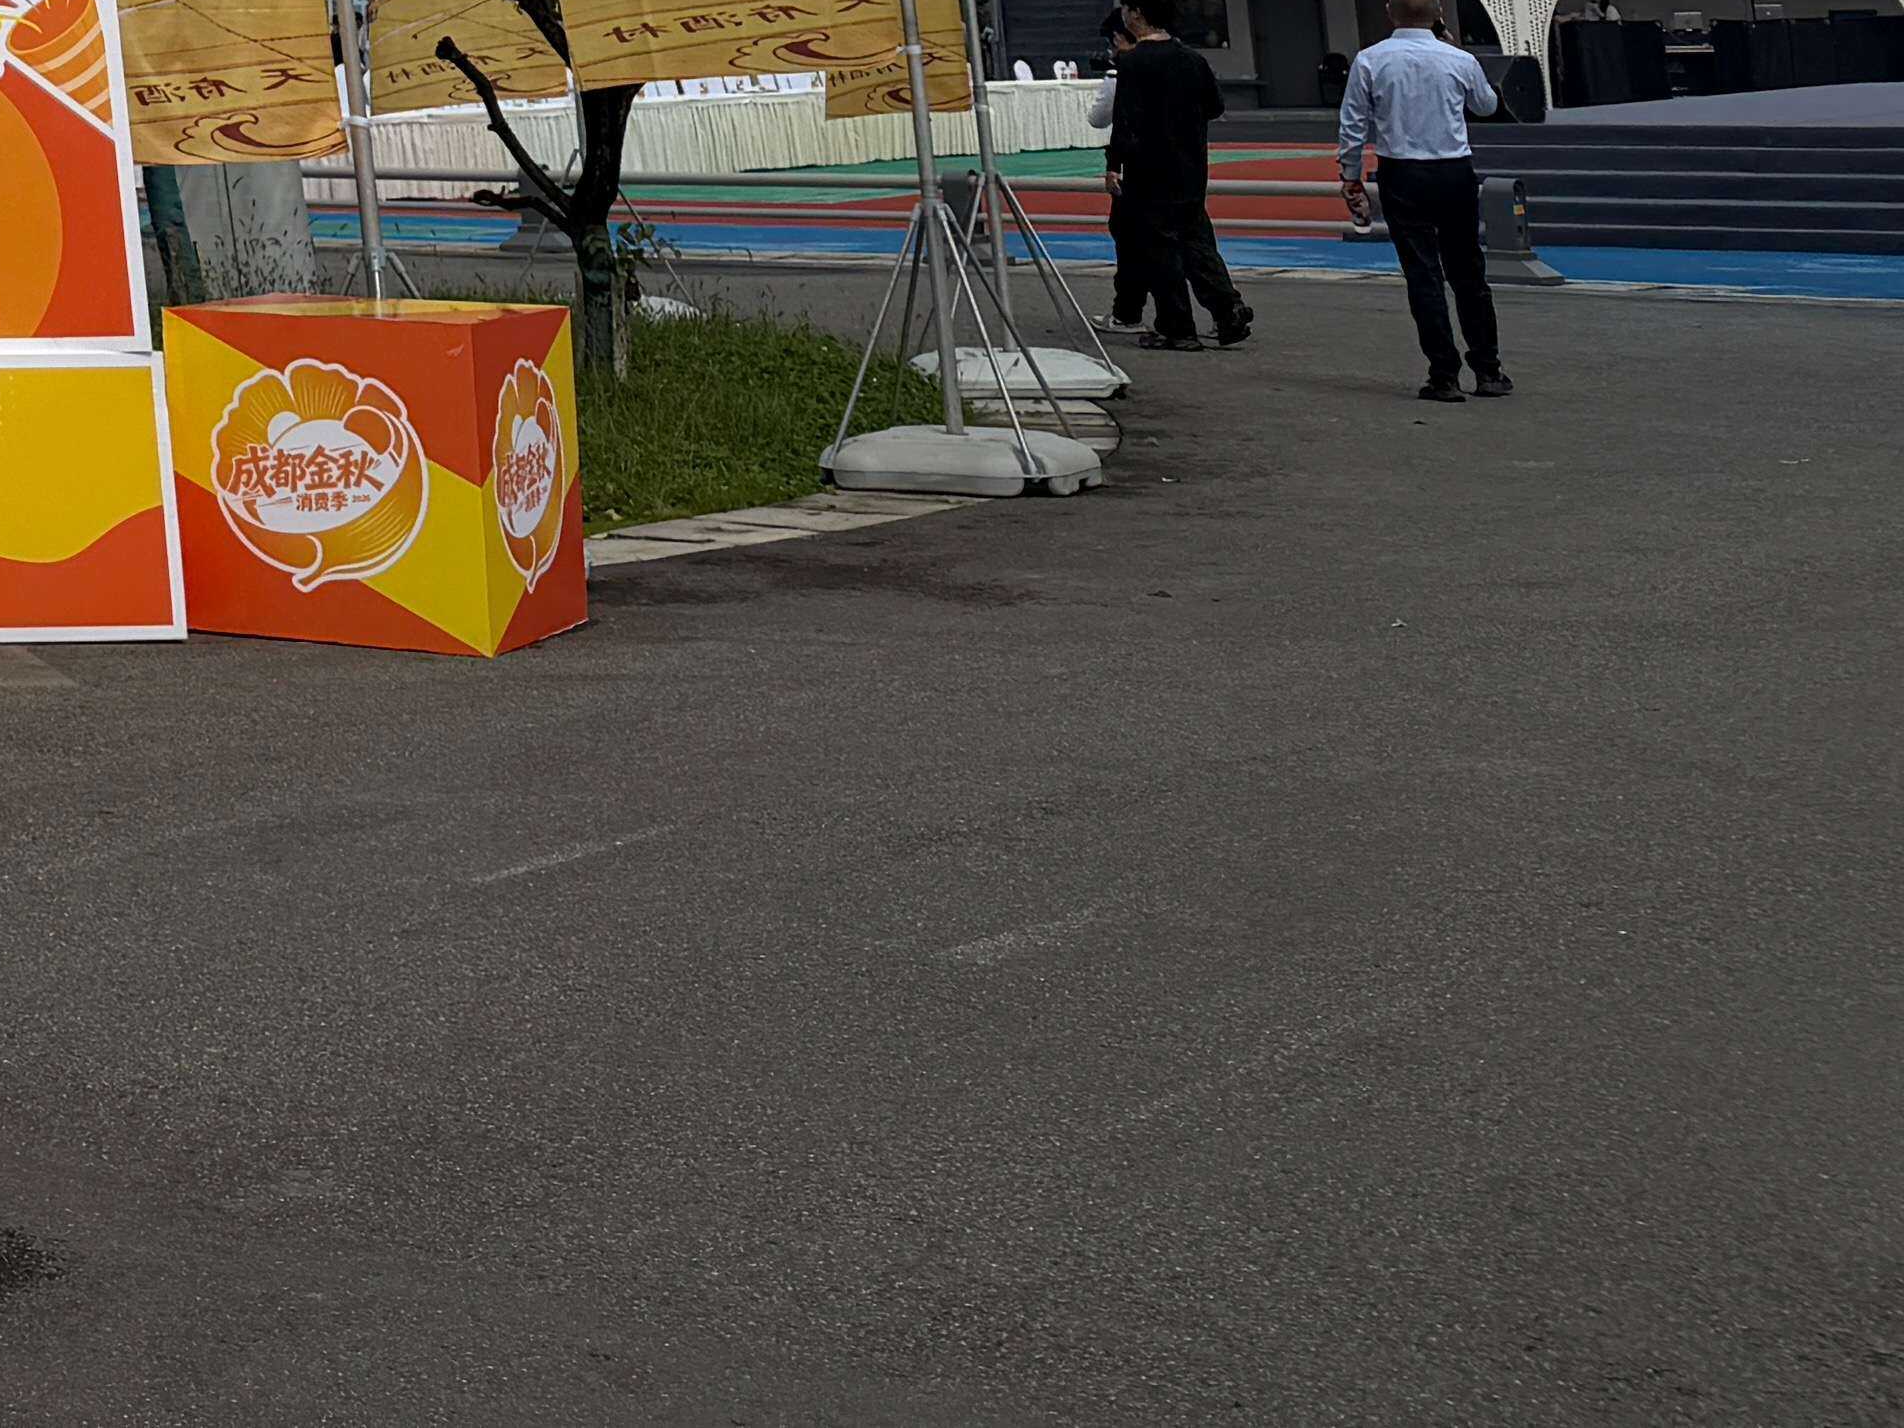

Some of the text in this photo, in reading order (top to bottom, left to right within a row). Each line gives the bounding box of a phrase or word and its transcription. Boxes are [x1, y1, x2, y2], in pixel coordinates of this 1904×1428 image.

[227, 443, 384, 497] 成都金秋
[296, 491, 349, 512] 消费季
